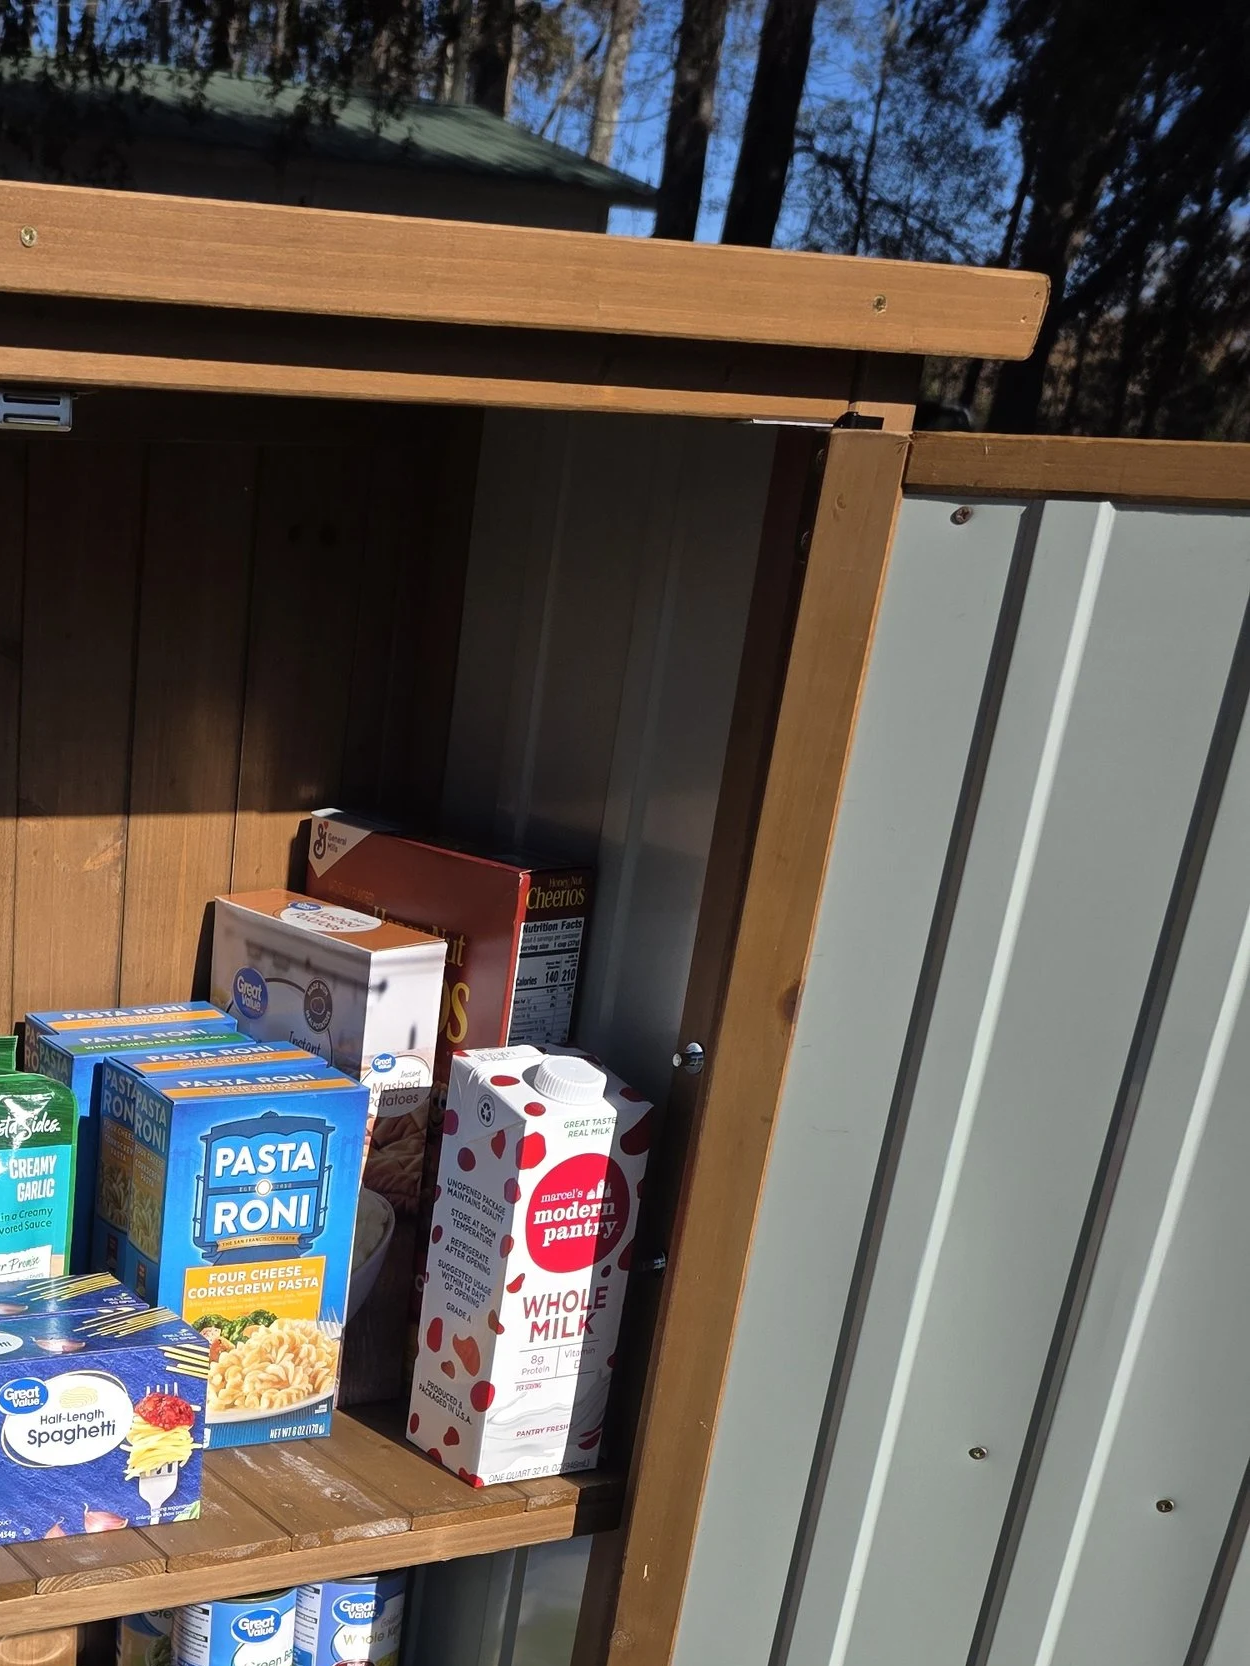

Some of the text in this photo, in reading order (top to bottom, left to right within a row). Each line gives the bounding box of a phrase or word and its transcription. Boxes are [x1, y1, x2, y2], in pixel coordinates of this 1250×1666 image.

[328, 833, 347, 845] General
[327, 842, 338, 852] Mills
[526, 887, 585, 909] Cheerios
[523, 919, 582, 933] Nutrition Facts
[546, 971, 558, 983] 140
[562, 969, 575, 982] 210
[237, 975, 262, 1000] Great
[241, 995, 262, 1012] Value
[62, 1010, 129, 1019] PASTA
[133, 1005, 187, 1015] RONI
[374, 1057, 392, 1066] Great
[177, 1078, 252, 1088] PASTA
[255, 1074, 314, 1083] RONI
[372, 1078, 420, 1094] Mashed
[369, 1094, 419, 1108] Potatoes
[563, 1116, 618, 1129] GREAT TASTE
[568, 1127, 611, 1138] REAL MILK
[9, 1154, 57, 1179] CREAMY
[215, 1141, 316, 1178] PASTA
[17, 1179, 55, 1202] GARLIC
[447, 1178, 506, 1216] UNOPENED PACKAGE
[541, 1188, 584, 1203] marcel's
[447, 1187, 504, 1224] MAINTAINS QUALITY
[533, 1201, 616, 1225] modern
[0, 1213, 10, 1222] in
[18, 1207, 53, 1221] Creamy
[213, 1194, 309, 1235] RONI
[25, 1219, 52, 1230] Sauce
[542, 1218, 617, 1248] pantry
[209, 1266, 302, 1284] FOUR CHEESE
[187, 1277, 319, 1299] CORKSCREW PASTA
[523, 1285, 608, 1320] WHOLE
[529, 1312, 595, 1343] MILK
[531, 1355, 544, 1365] 8g
[522, 1366, 550, 1375] Protein
[3, 1388, 40, 1401] Great
[12, 1396, 40, 1406] Value
[40, 1409, 105, 1426] Half-Length
[27, 1419, 116, 1447] Spaghetti
[516, 1424, 568, 1437] PANTRY FRESH
[238, 1616, 275, 1630] Great
[247, 1625, 275, 1637] Value
